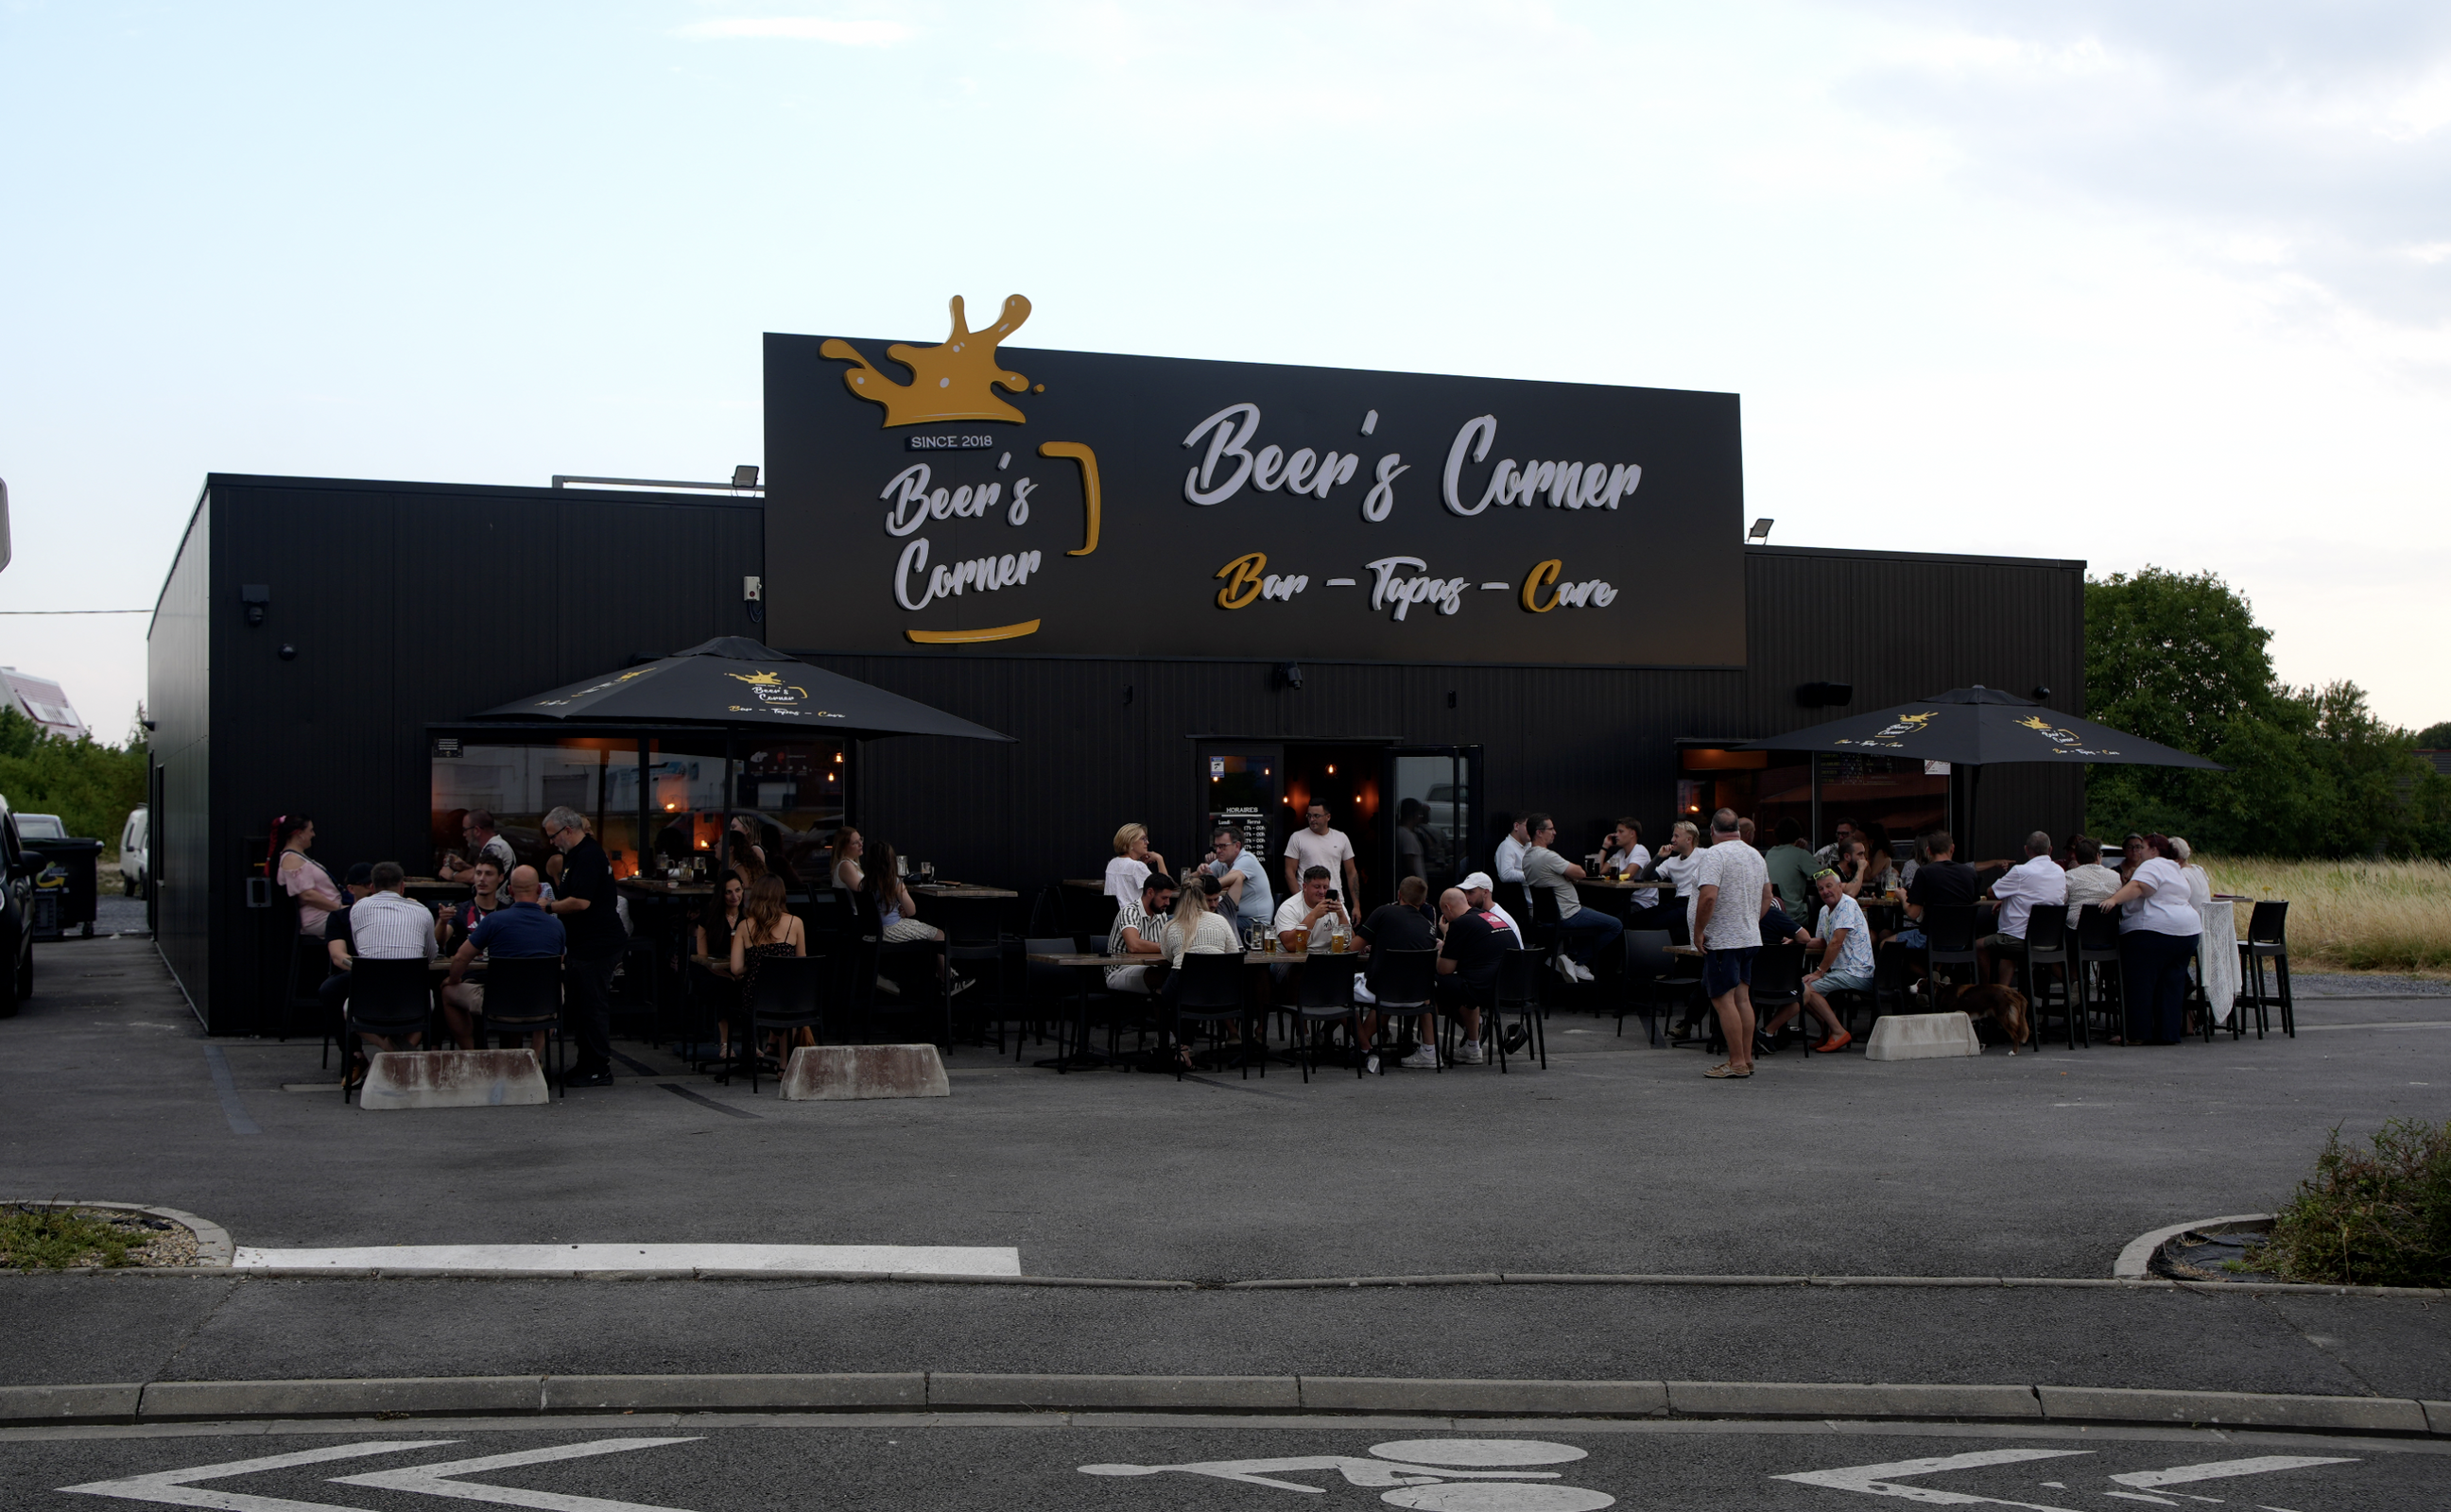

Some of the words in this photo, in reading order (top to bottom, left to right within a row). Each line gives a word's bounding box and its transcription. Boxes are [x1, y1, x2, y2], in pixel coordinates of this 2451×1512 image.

[911, 436, 958, 448] SINCE
[961, 435, 993, 447] 2018
[1182, 403, 1410, 523] Beer's
[1442, 414, 1642, 517] Corner
[880, 452, 1039, 537] Beer's
[894, 538, 1042, 610] Corner
[1215, 552, 1308, 610] Bar
[1365, 556, 1471, 622] Tapas
[751, 686, 789, 695] Beer's
